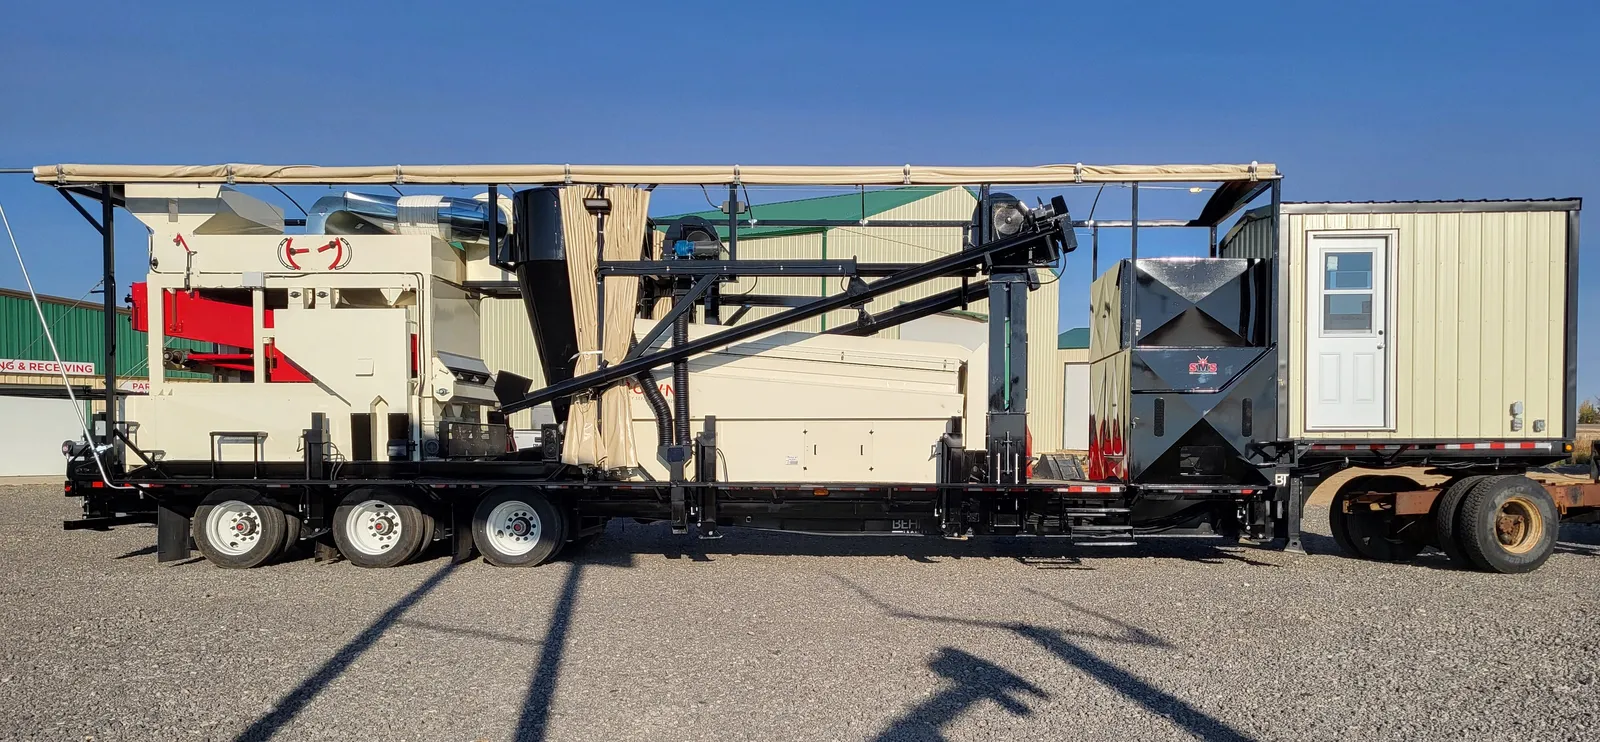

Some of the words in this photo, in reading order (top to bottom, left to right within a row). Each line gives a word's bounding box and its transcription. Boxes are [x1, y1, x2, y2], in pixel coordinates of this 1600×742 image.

[18, 362, 26, 371] &
[29, 362, 93, 373] RECEVING
[1189, 362, 1217, 372] SMS
